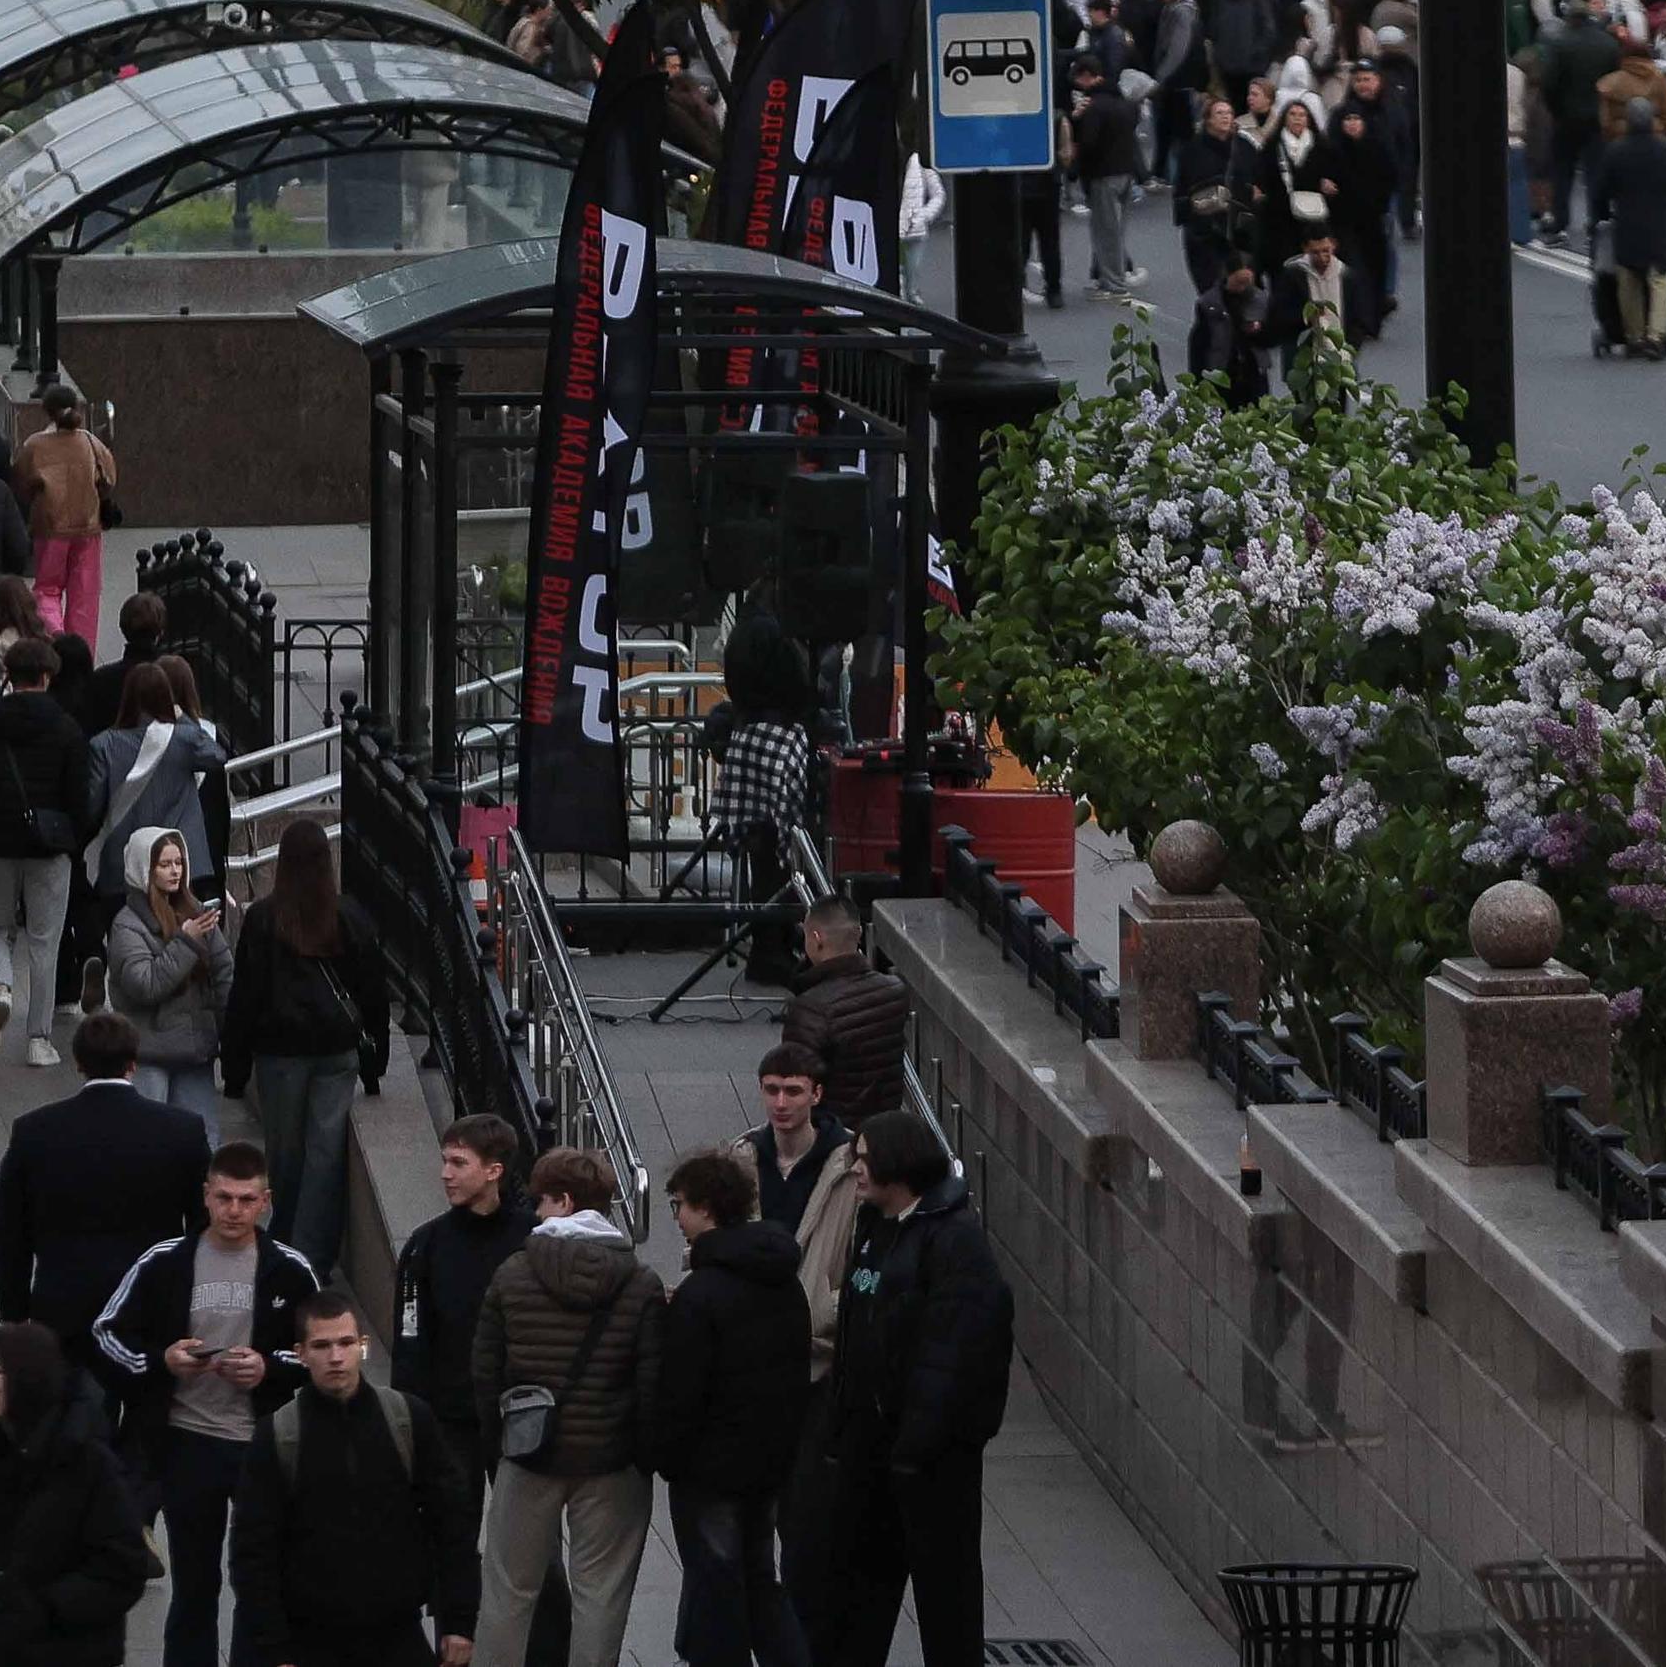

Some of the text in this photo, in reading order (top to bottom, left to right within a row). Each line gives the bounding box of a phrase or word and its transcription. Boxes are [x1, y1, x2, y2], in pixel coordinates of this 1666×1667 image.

[745, 79, 790, 249] ФЕДЕРАЛЬНАЯ
[525, 202, 602, 726] ФЕДЕРАЛЬНАЯ АКАДЕМИЯ ВОЖДЕНИЯ
